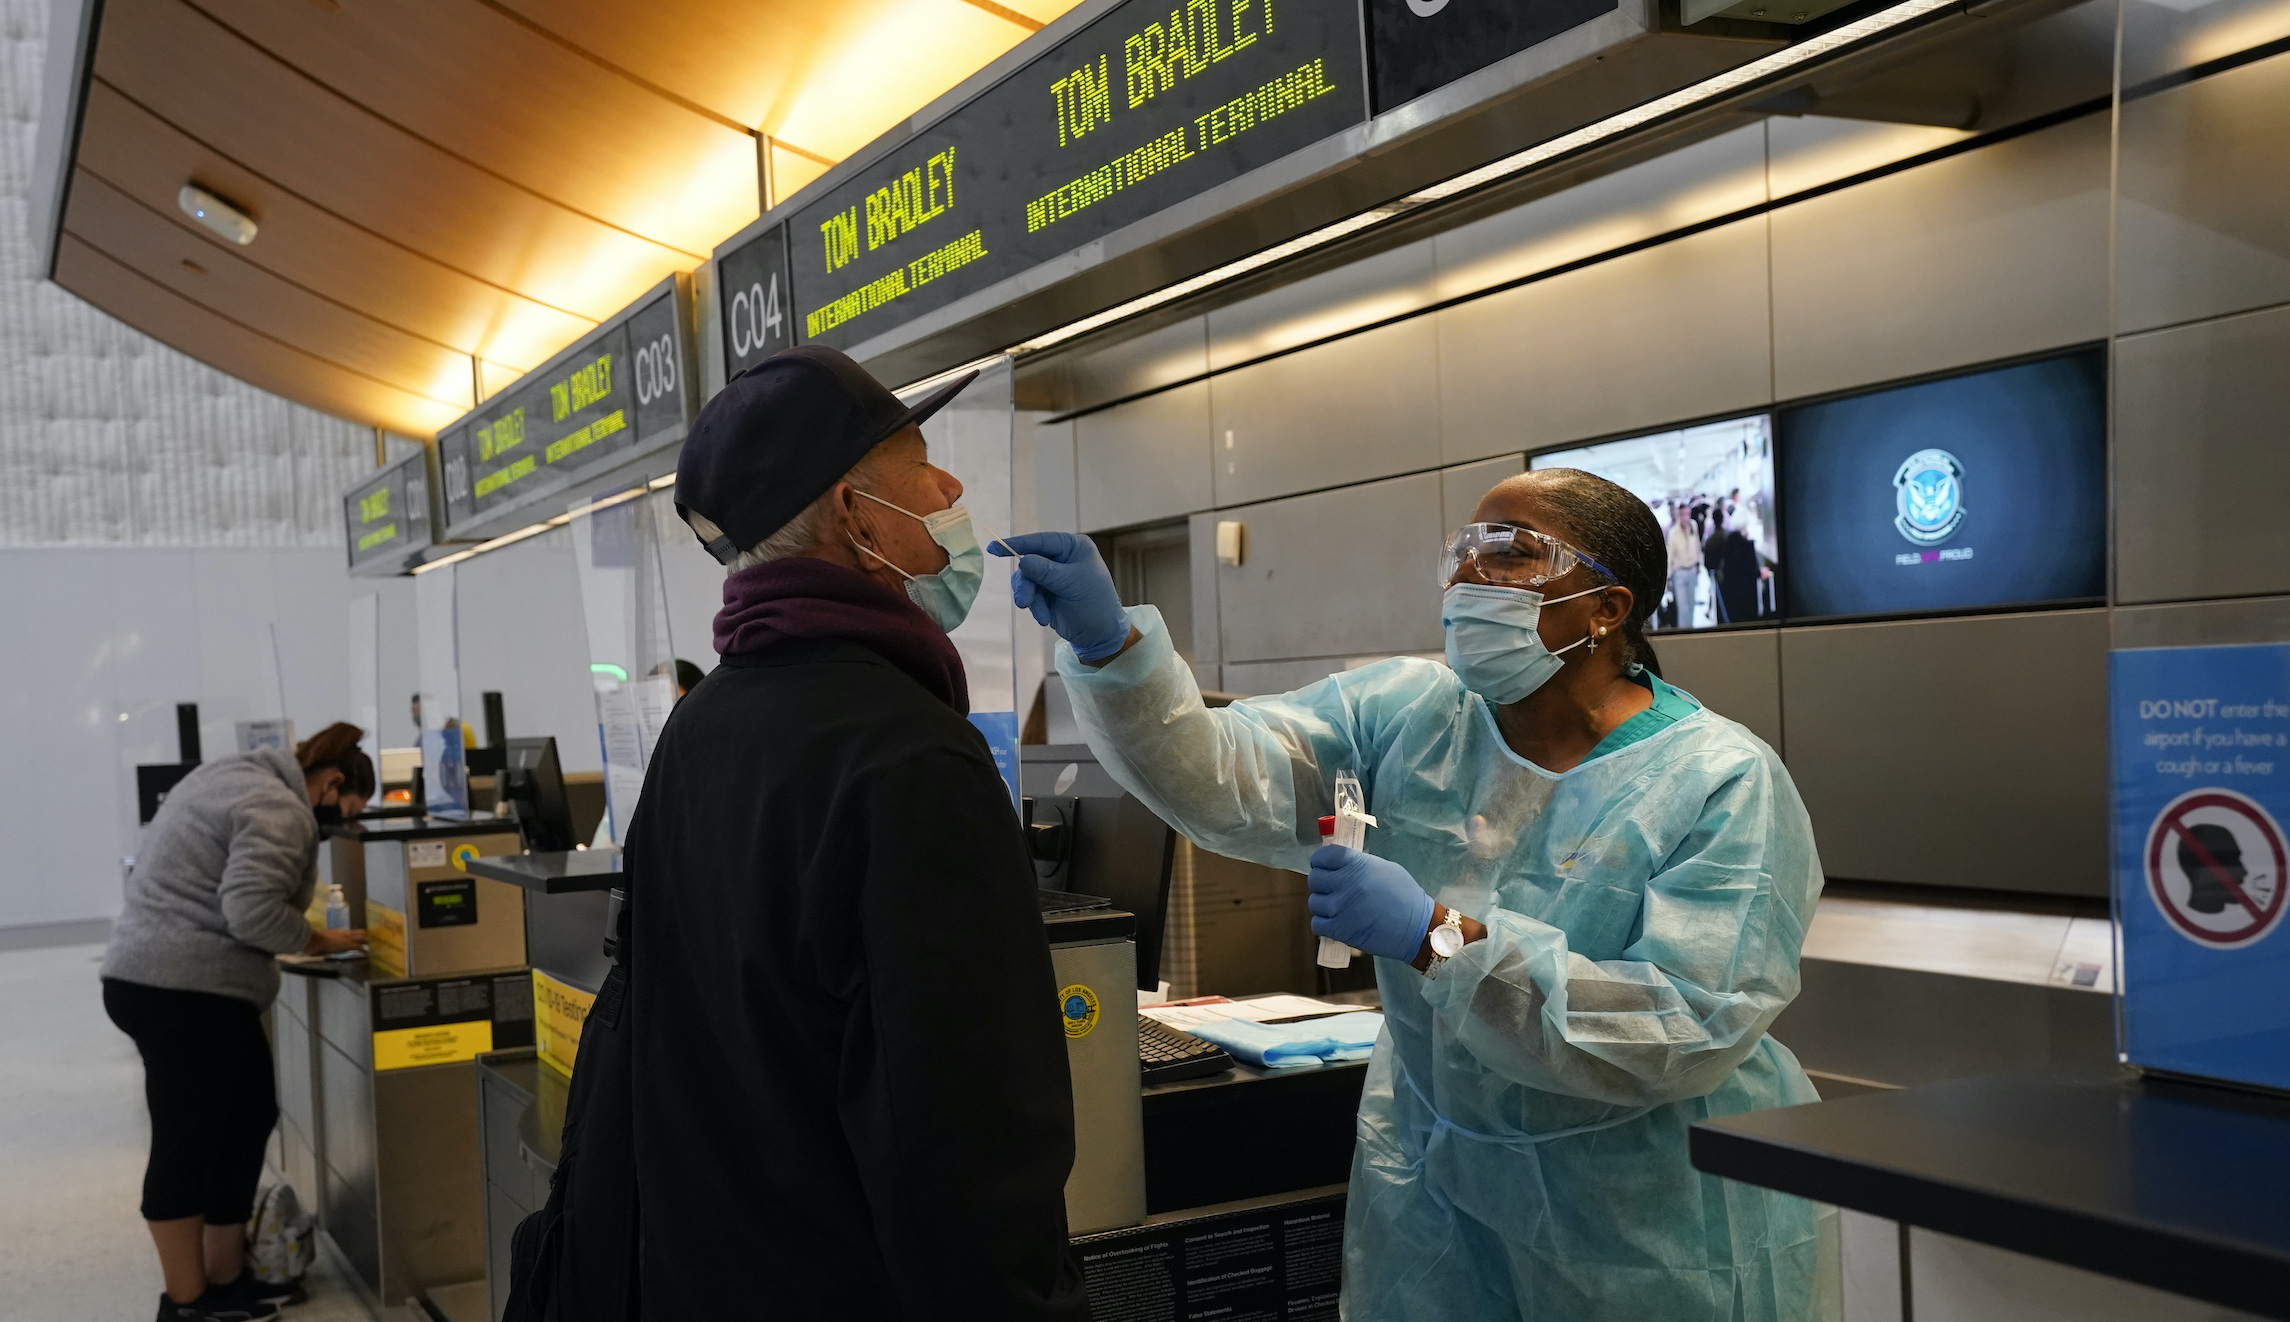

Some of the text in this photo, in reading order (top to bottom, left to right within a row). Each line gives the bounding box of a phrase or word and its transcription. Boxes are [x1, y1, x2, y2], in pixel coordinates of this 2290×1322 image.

[1050, 53, 1111, 148] TOM
[1026, 57, 1336, 234] INTERNATIONAL TERMINAL
[820, 145, 956, 274] TOM BRADLEY
[731, 272, 783, 359] C04
[806, 229, 989, 339] INTERNATIONAL TERMINAL
[635, 333, 676, 406] C03
[2140, 700, 2172, 719] DO
[2173, 698, 2218, 719] NOT
[2220, 704, 2260, 719] enter
[2143, 726, 2288, 752] airport if you have a
[2156, 754, 2274, 779] cough or a fever
[1082, 988, 1097, 1008] ANGELES
[1083, 1254, 1101, 1262] Notice
[1108, 1246, 1144, 1258] Overbooking
